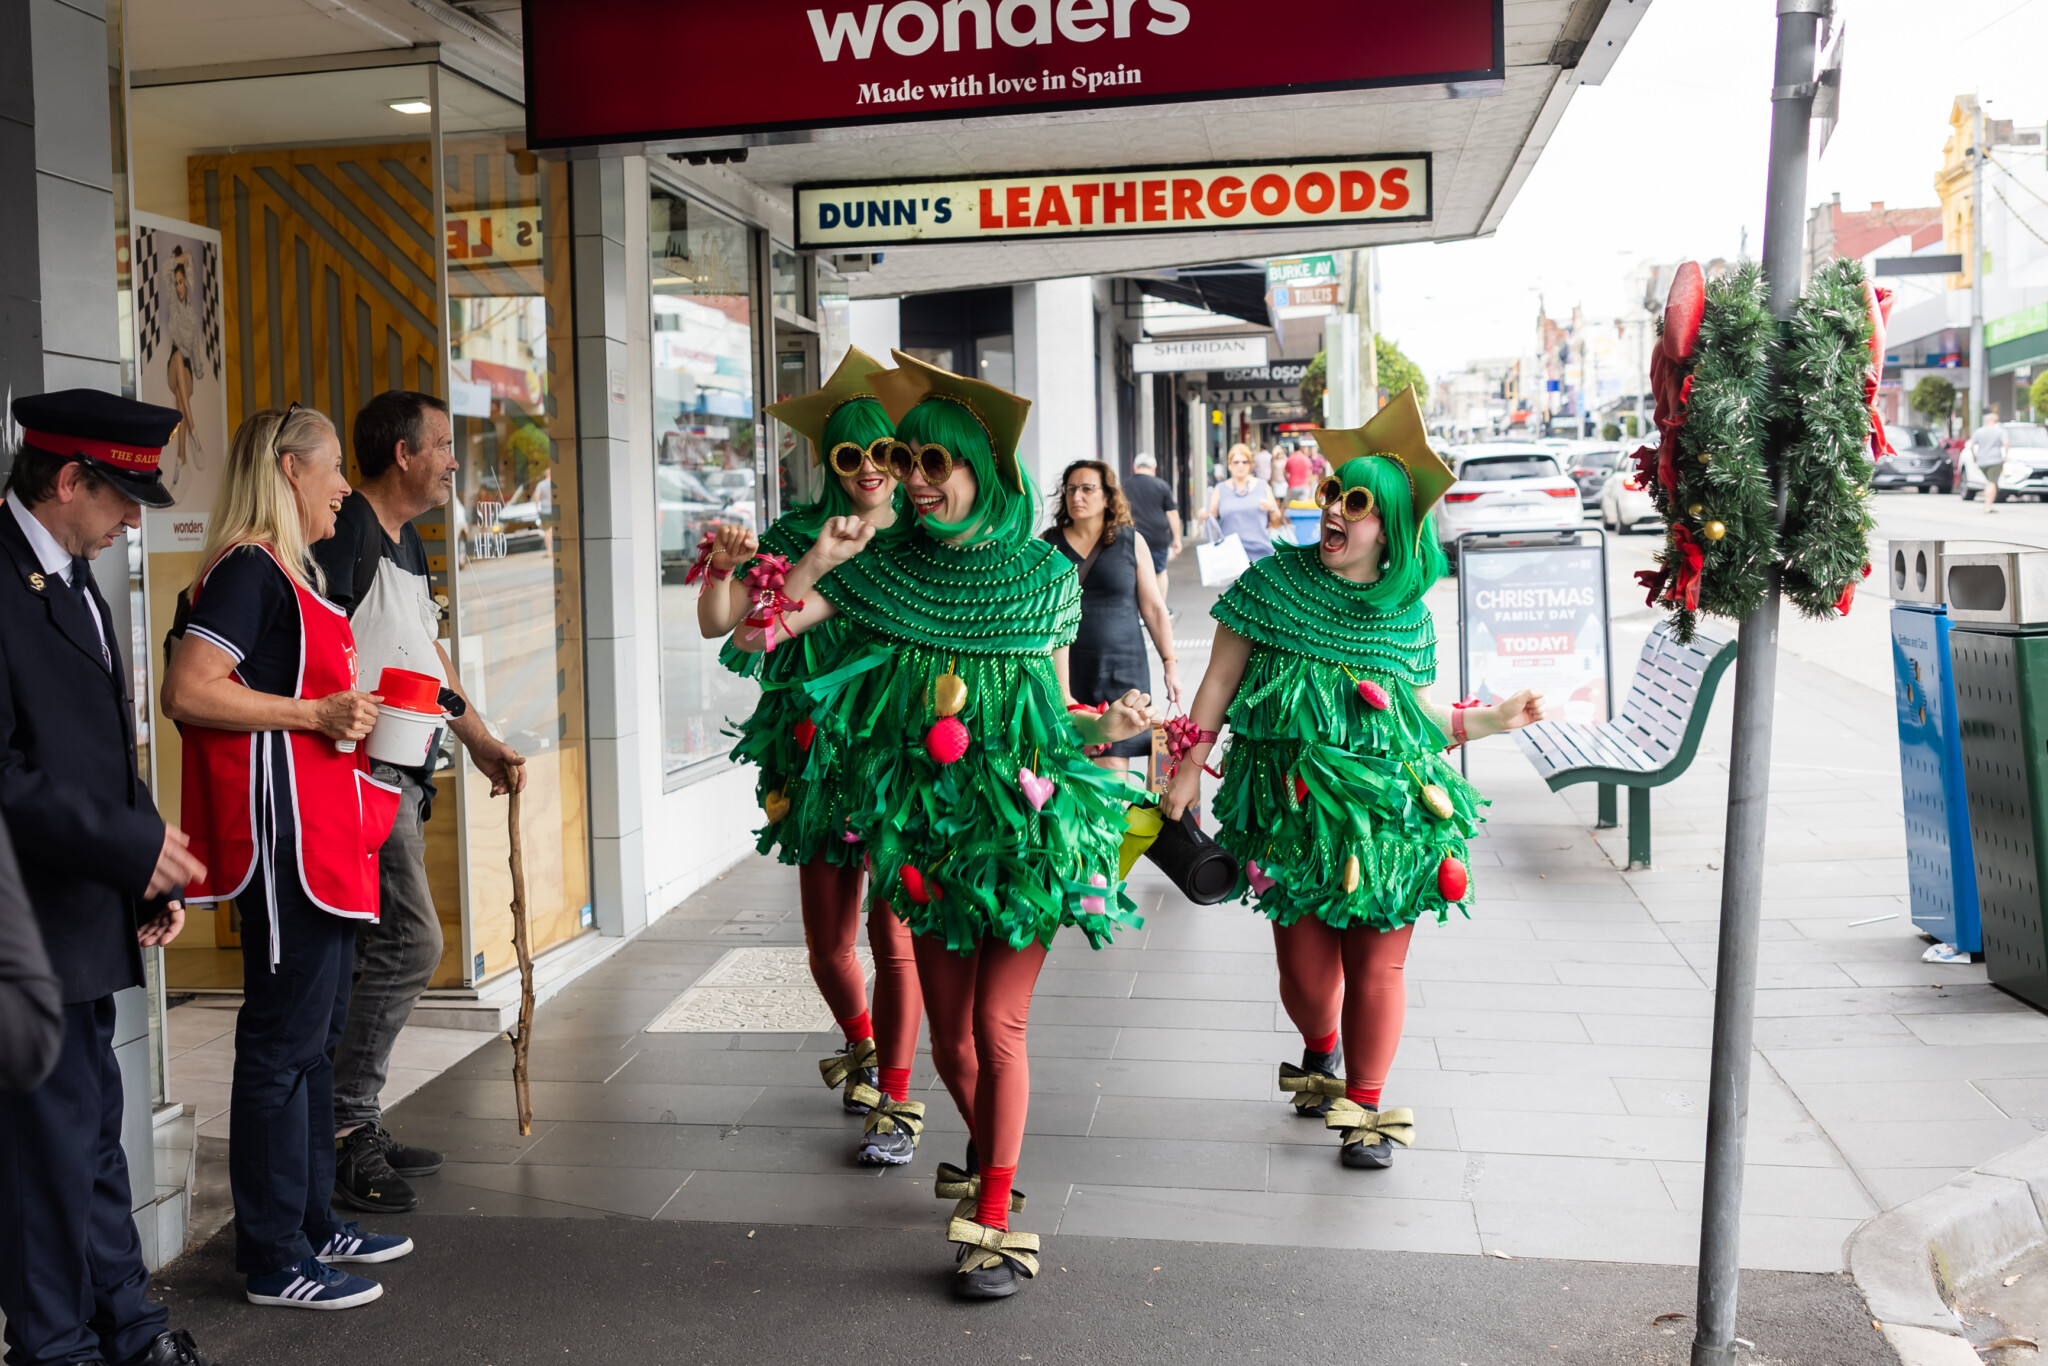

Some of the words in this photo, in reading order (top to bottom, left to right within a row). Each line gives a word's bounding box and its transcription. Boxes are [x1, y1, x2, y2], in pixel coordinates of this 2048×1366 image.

[806, 0, 1191, 63] wonders
[856, 79, 924, 105] Made
[929, 74, 983, 99] with
[988, 71, 1037, 95] love
[1042, 68, 1067, 91] in
[1072, 64, 1142, 94] Spain
[818, 196, 952, 230] DUNN'S
[979, 167, 1410, 230] LEATHERGOODS
[1269, 263, 1312, 281] BURKE
[1315, 260, 1331, 276] AV
[1294, 287, 1333, 304] TOILETS
[1154, 341, 1247, 356] SHERIDAN
[1223, 367, 1271, 382] OSCAR
[1271, 365, 1308, 381] OSCA
[111, 449, 133, 462] THE
[476, 501, 502, 528] STEP
[173, 519, 204, 534] wonders
[473, 533, 508, 560] AHEAD
[1476, 587, 1594, 609] CHRISTMAS
[1495, 610, 1545, 621] FAMILY
[1549, 609, 1577, 620] DAY
[1502, 635, 1569, 653] TODAY!
